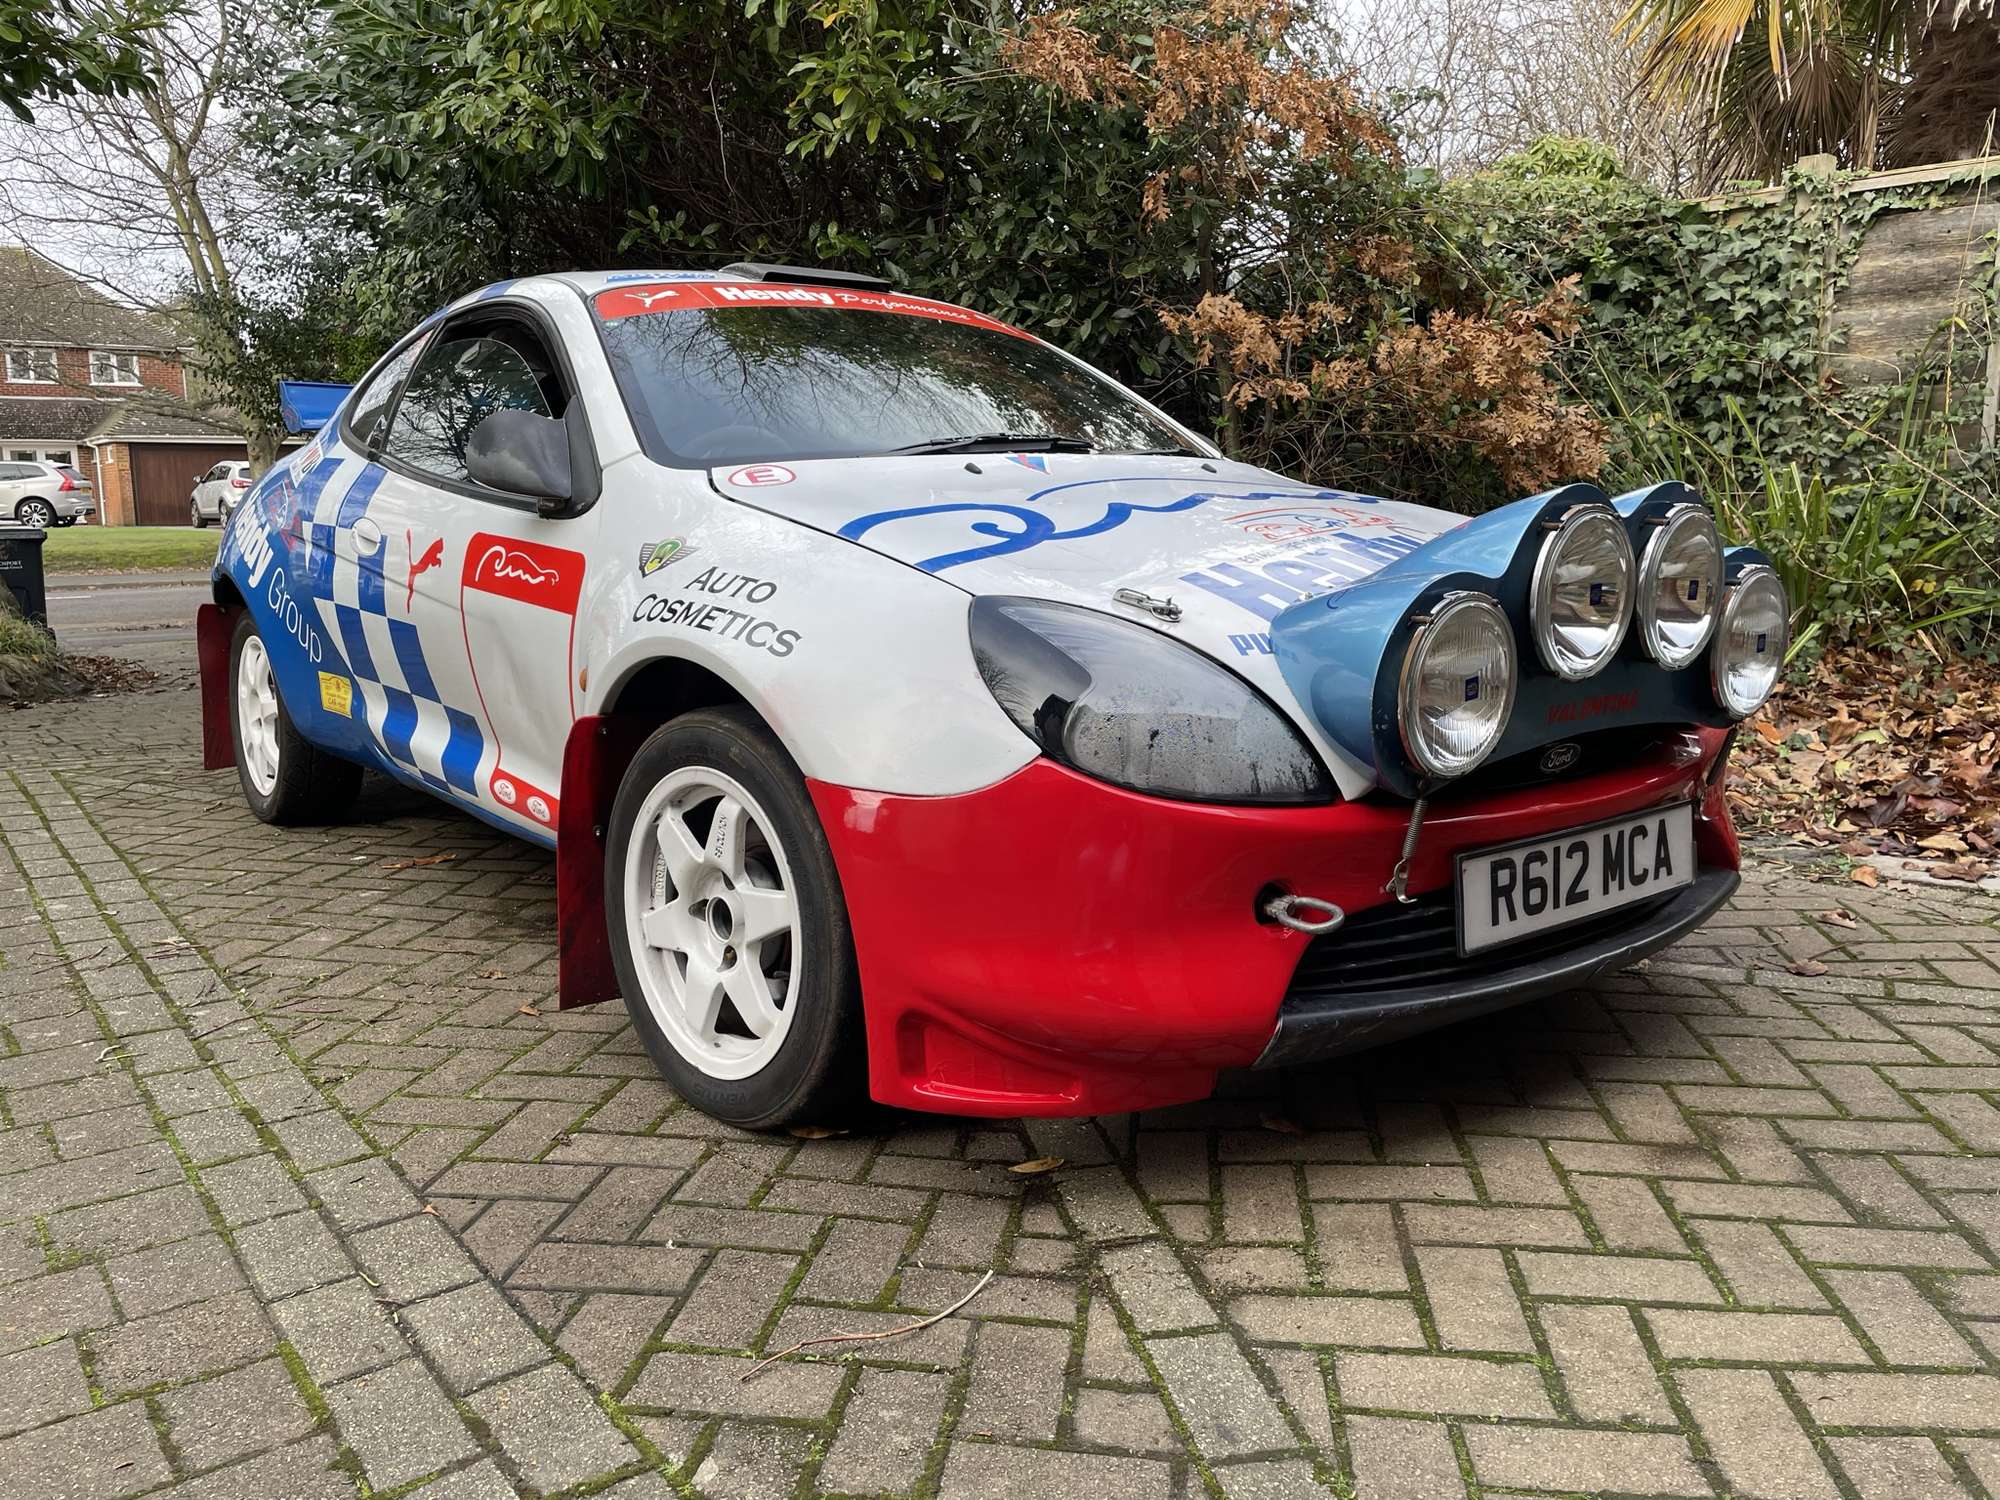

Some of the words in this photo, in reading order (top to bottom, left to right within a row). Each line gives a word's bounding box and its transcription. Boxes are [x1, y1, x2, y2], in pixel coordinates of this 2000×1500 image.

[713, 287, 835, 305] Hendy
[836, 293, 970, 320] Performance
[683, 566, 778, 604] AUTO
[268, 567, 322, 664] Group
[632, 593, 803, 658] COSMETICS
[1547, 747, 1574, 768] Ford
[1490, 840, 1590, 927] R612
[1602, 818, 1673, 896] MCA
